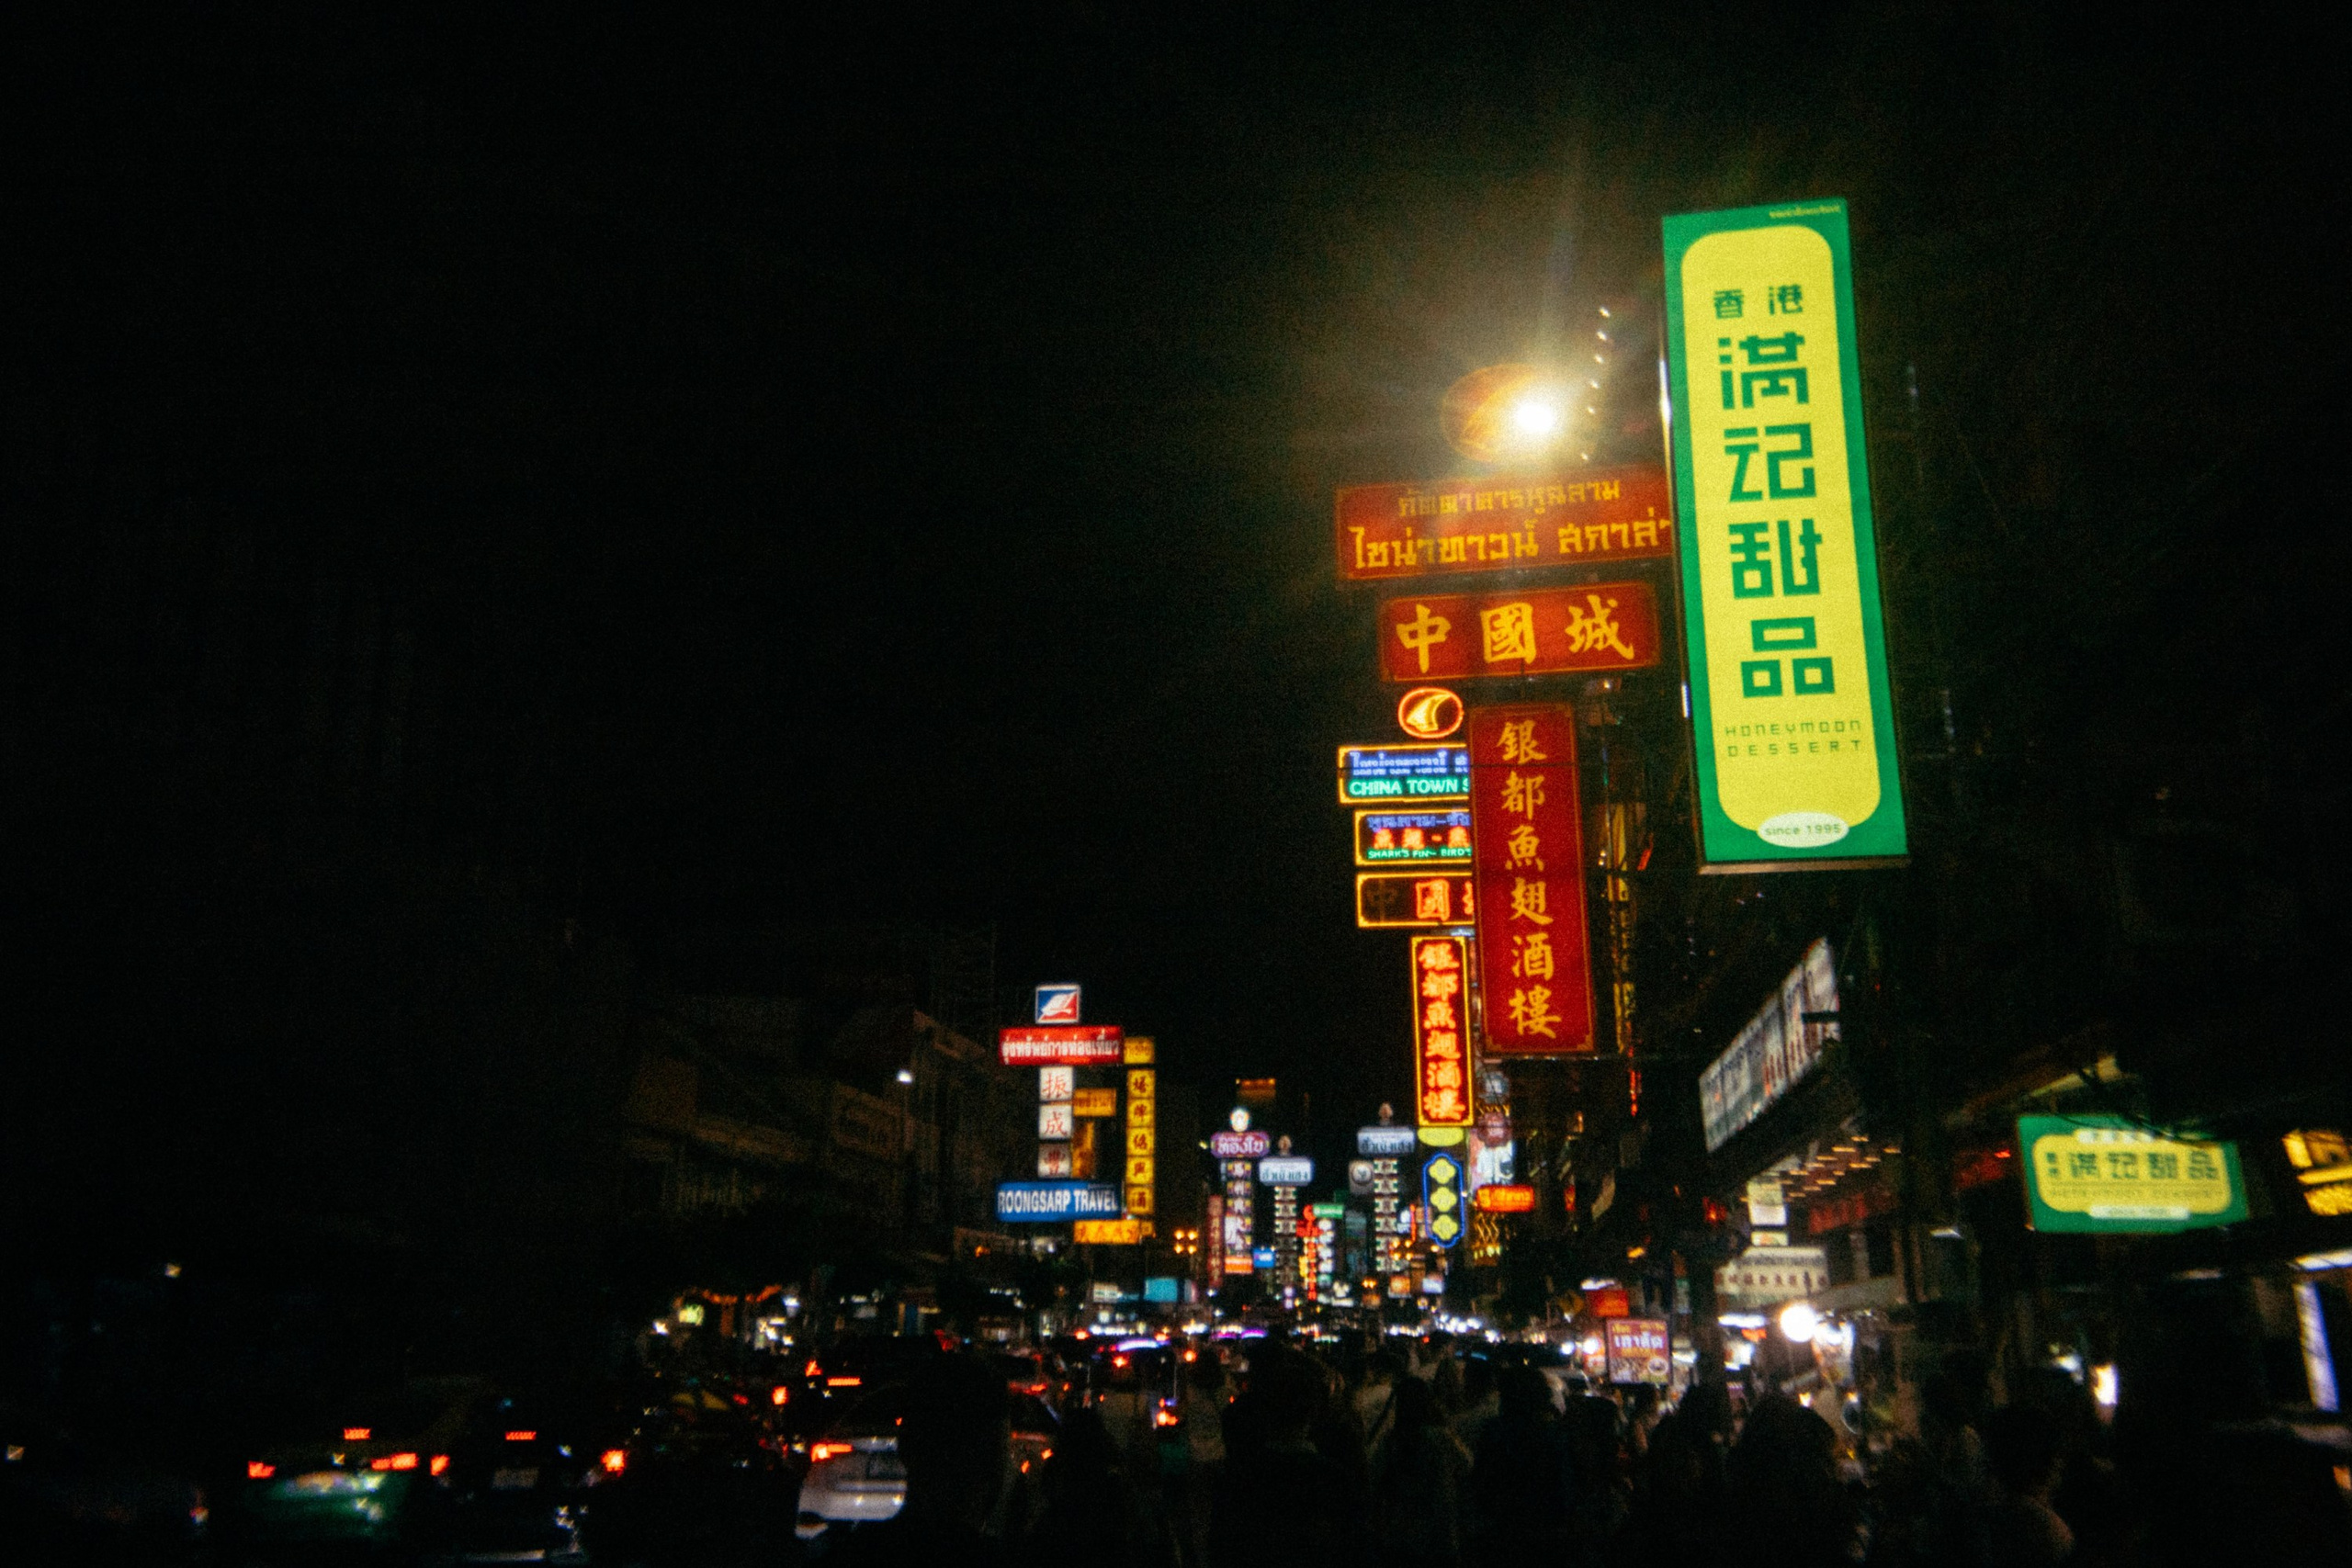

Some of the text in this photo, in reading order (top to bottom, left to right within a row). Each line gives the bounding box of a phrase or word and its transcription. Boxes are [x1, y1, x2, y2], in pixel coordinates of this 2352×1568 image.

[1713, 284, 1804, 319] 香港
[1347, 518, 1540, 570] ไชน่าทาวน์
[1396, 594, 1635, 674] 中國城
[1727, 739, 1861, 757] DESSERT
[1350, 780, 1403, 795] CHINA
[1407, 778, 1458, 794] TOWN
[1497, 719, 1562, 1040] 銀都魚翅酒樓
[997, 1189, 1119, 1213] ROONGSARP TRAVEL
